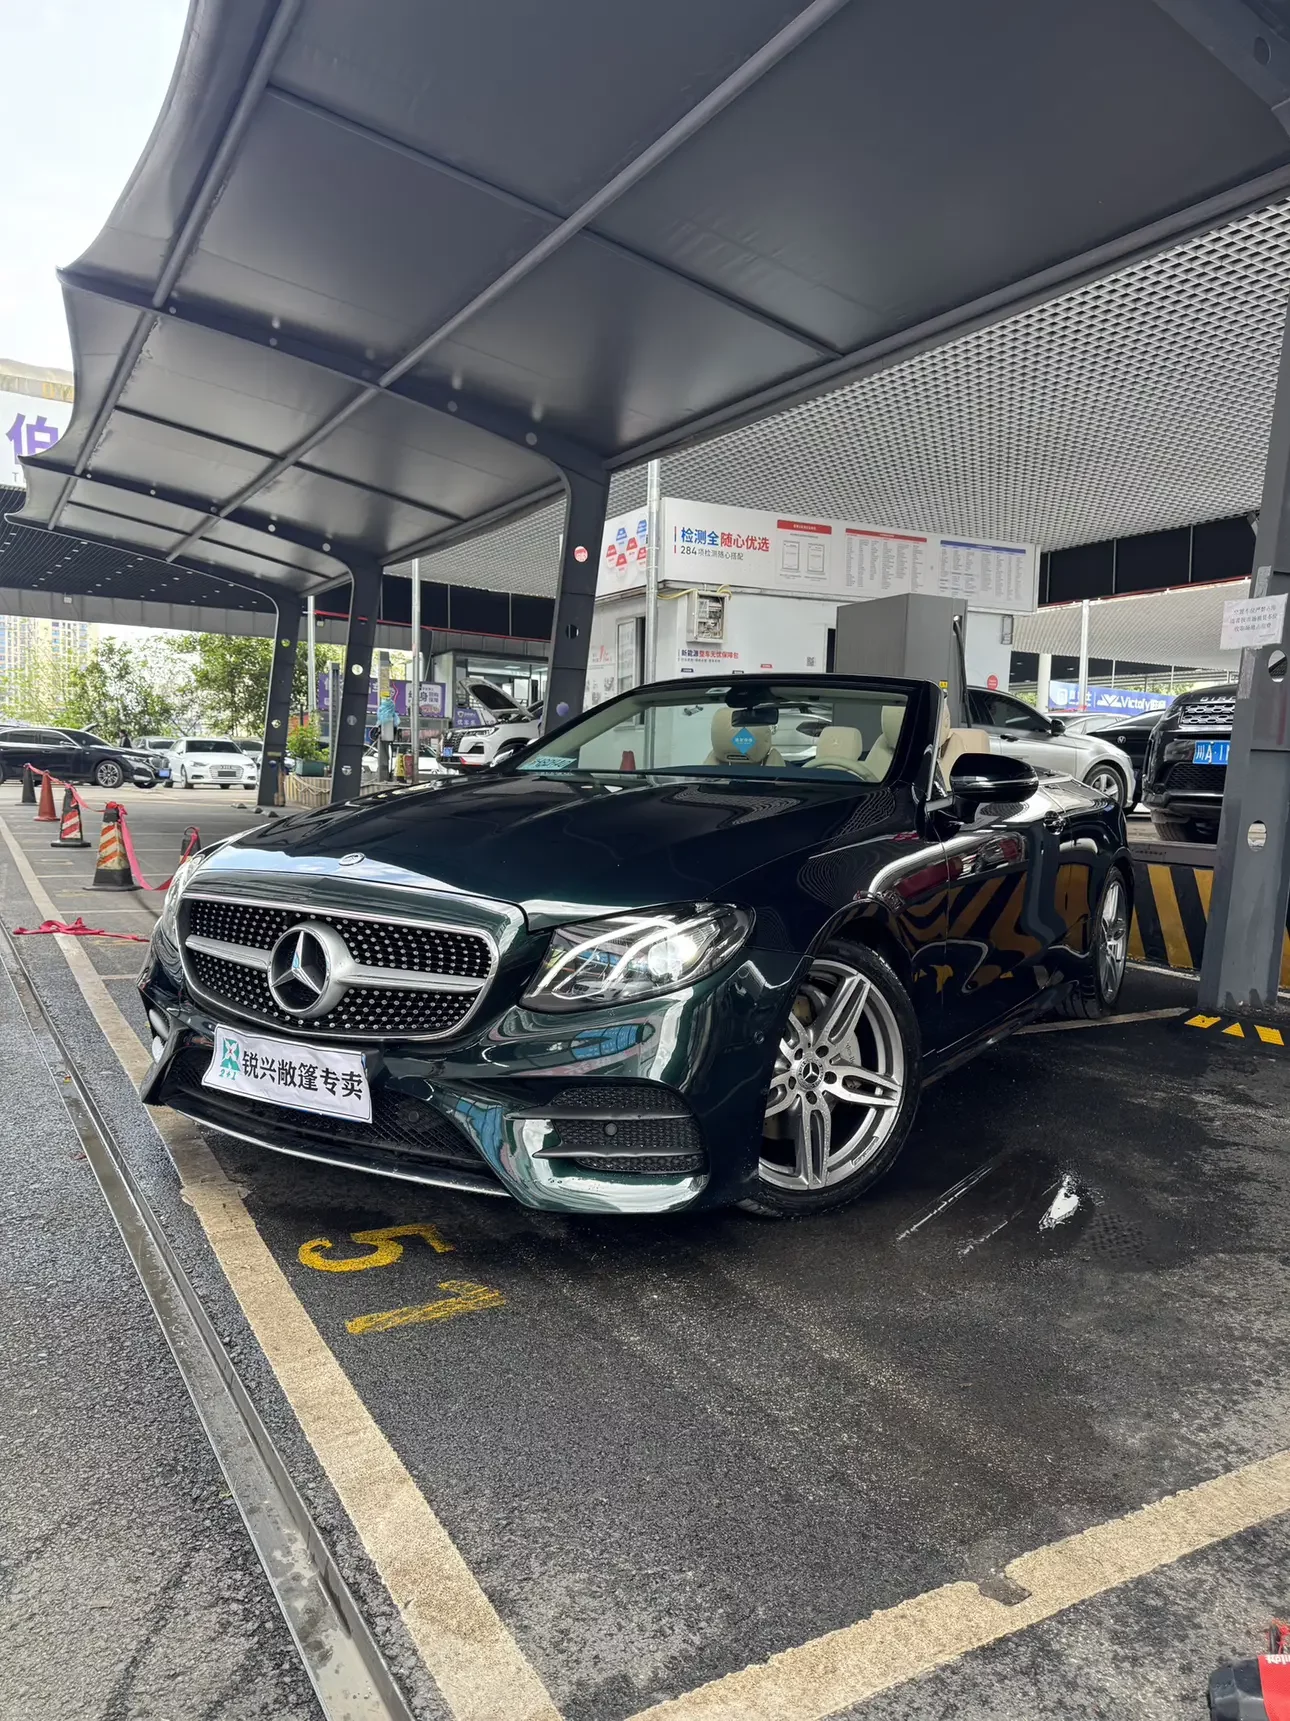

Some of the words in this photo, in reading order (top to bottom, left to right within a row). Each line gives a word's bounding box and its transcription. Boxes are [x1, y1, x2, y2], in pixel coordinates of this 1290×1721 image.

[6, 412, 58, 465] 伯
[681, 526, 770, 552] 检测全随心优选
[242, 1050, 363, 1101] 锐兴敞篷专卖
